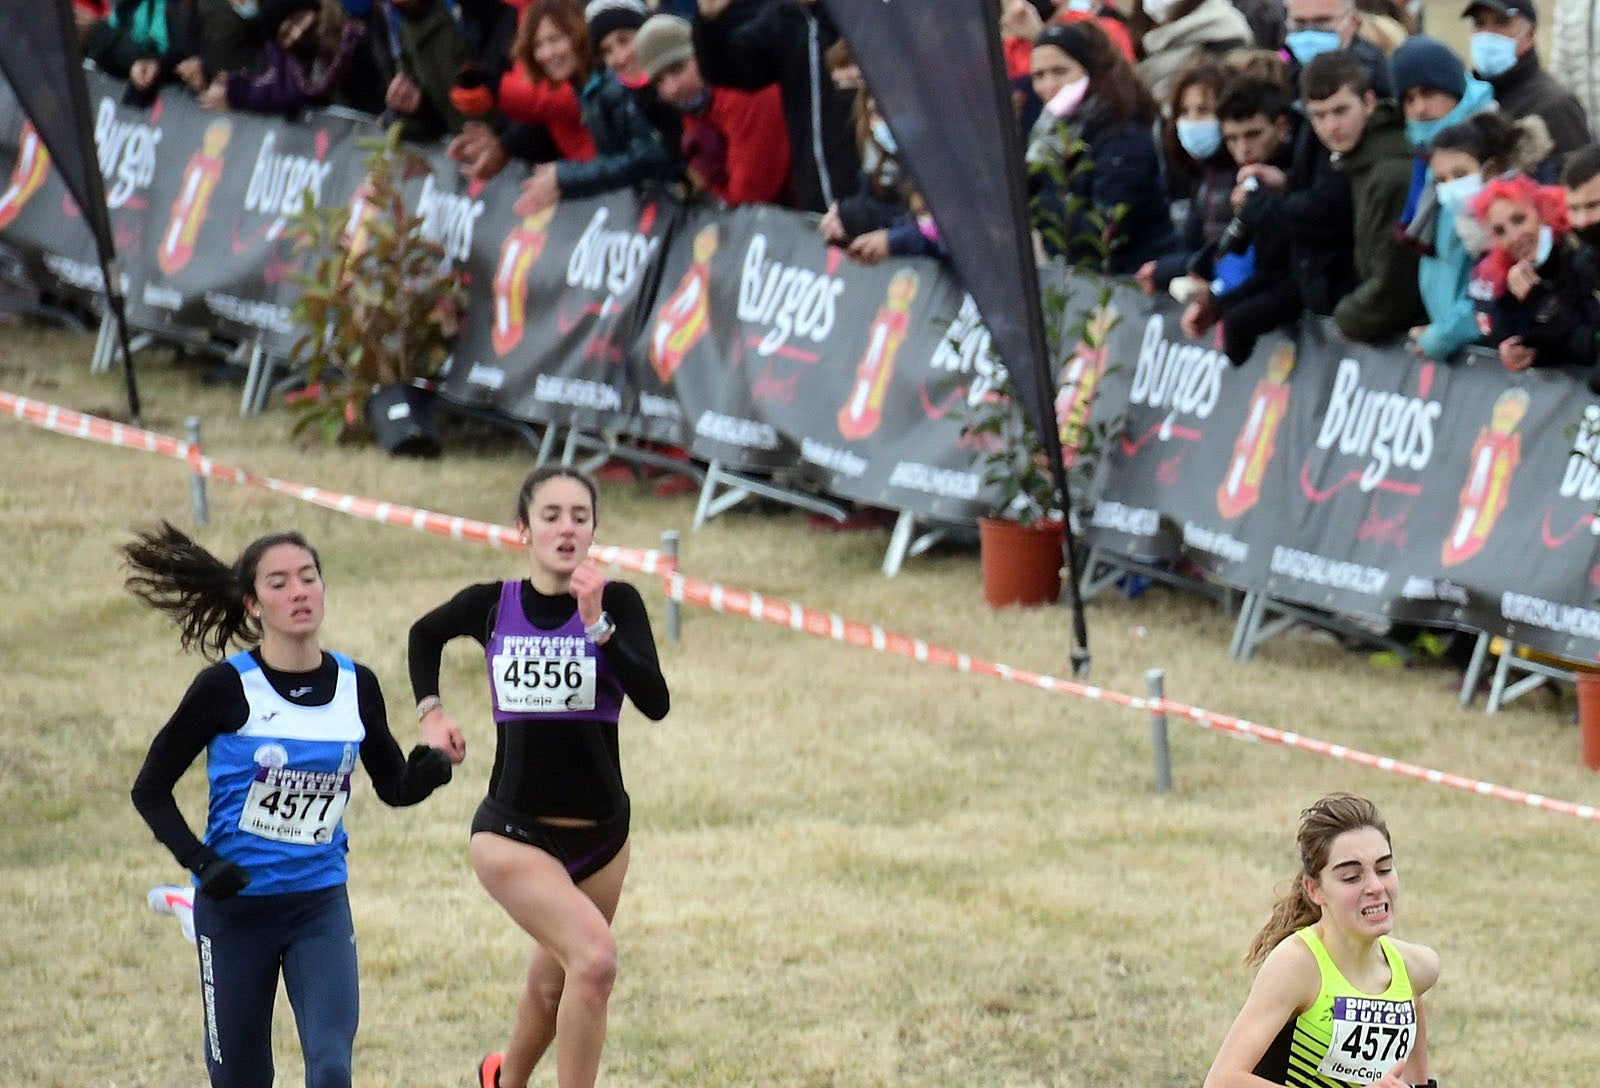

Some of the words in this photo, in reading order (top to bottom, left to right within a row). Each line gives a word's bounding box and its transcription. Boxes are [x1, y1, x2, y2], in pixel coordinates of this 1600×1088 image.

[737, 234, 845, 357] Burgos
[1129, 313, 1230, 441] Burgos
[1317, 358, 1442, 493] Burgos
[504, 660, 582, 689] 4556
[259, 791, 336, 822] 4577
[1345, 1009, 1413, 1025] BURGOS
[1341, 1024, 1410, 1062] 4578
[1332, 1062, 1382, 1082] iberCaja
